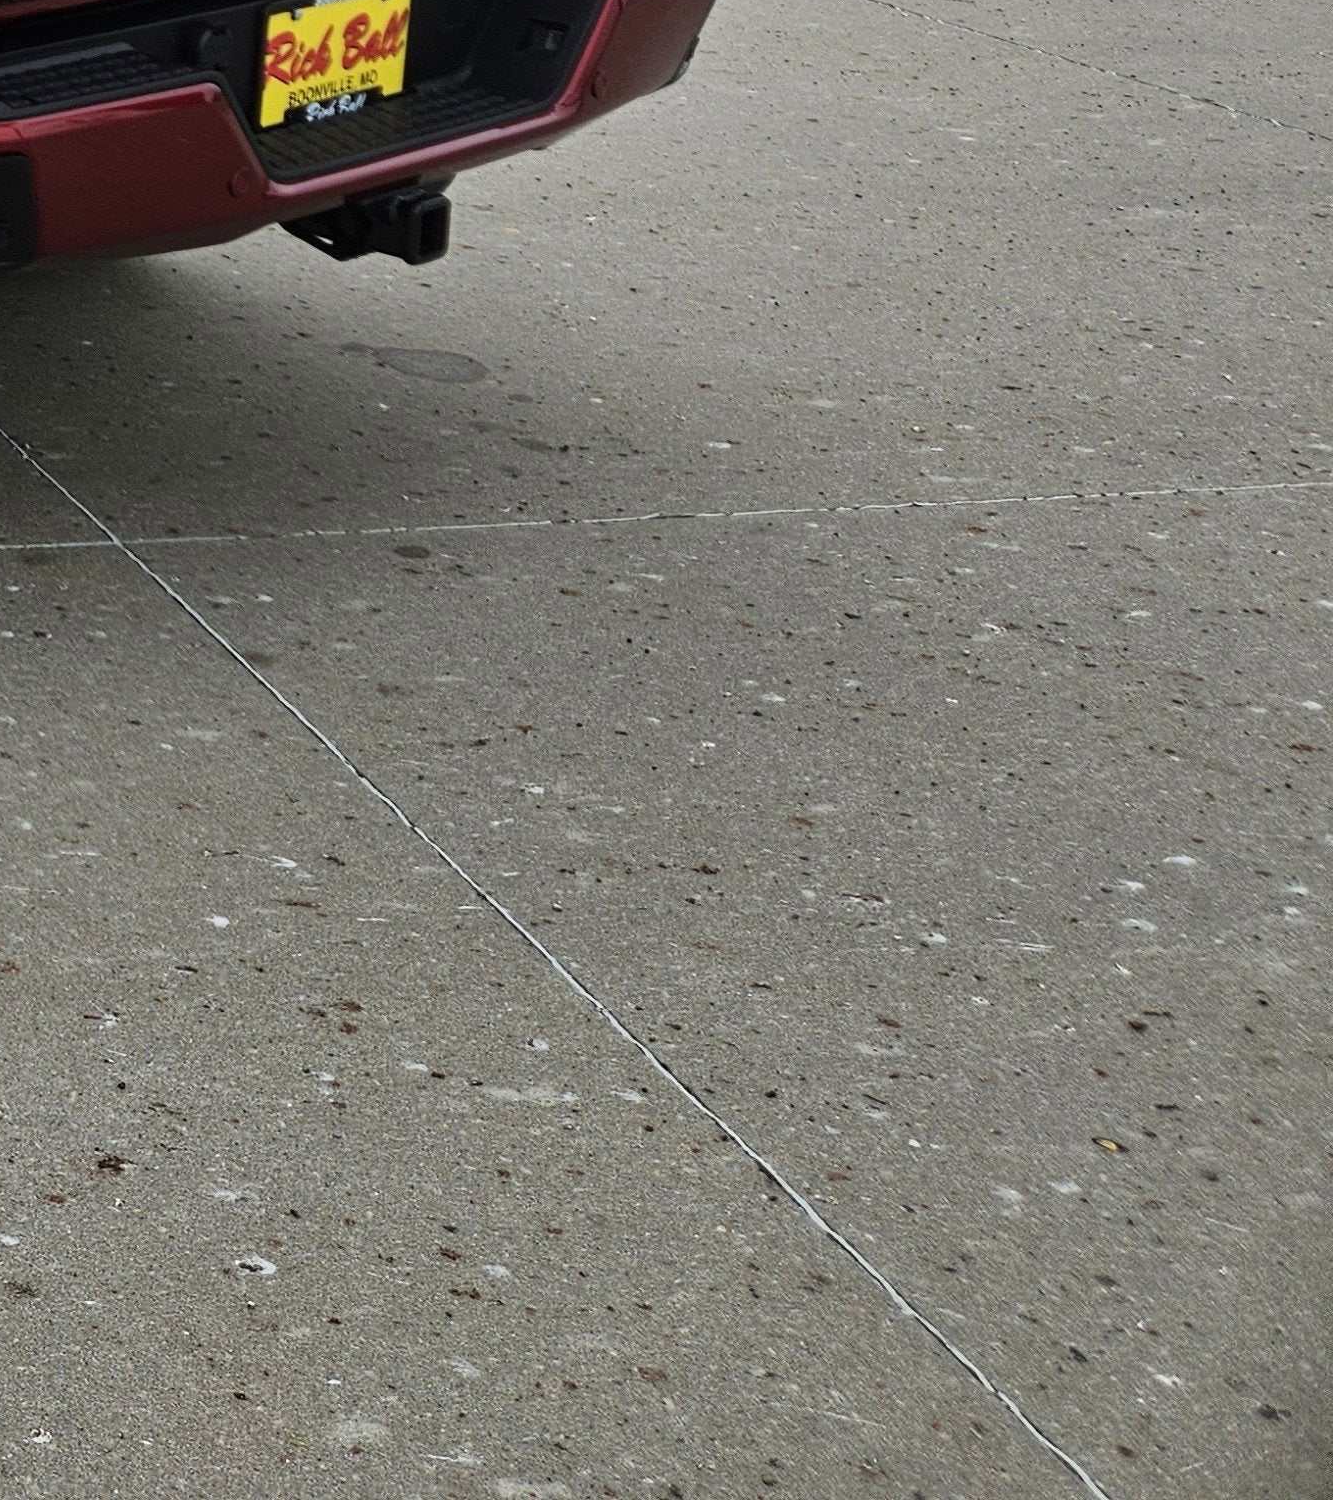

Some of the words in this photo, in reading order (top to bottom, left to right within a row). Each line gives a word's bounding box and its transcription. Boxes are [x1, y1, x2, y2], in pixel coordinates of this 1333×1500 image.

[265, 24, 334, 85] Rick
[342, 8, 410, 70] Ball
[360, 69, 379, 87] MO
